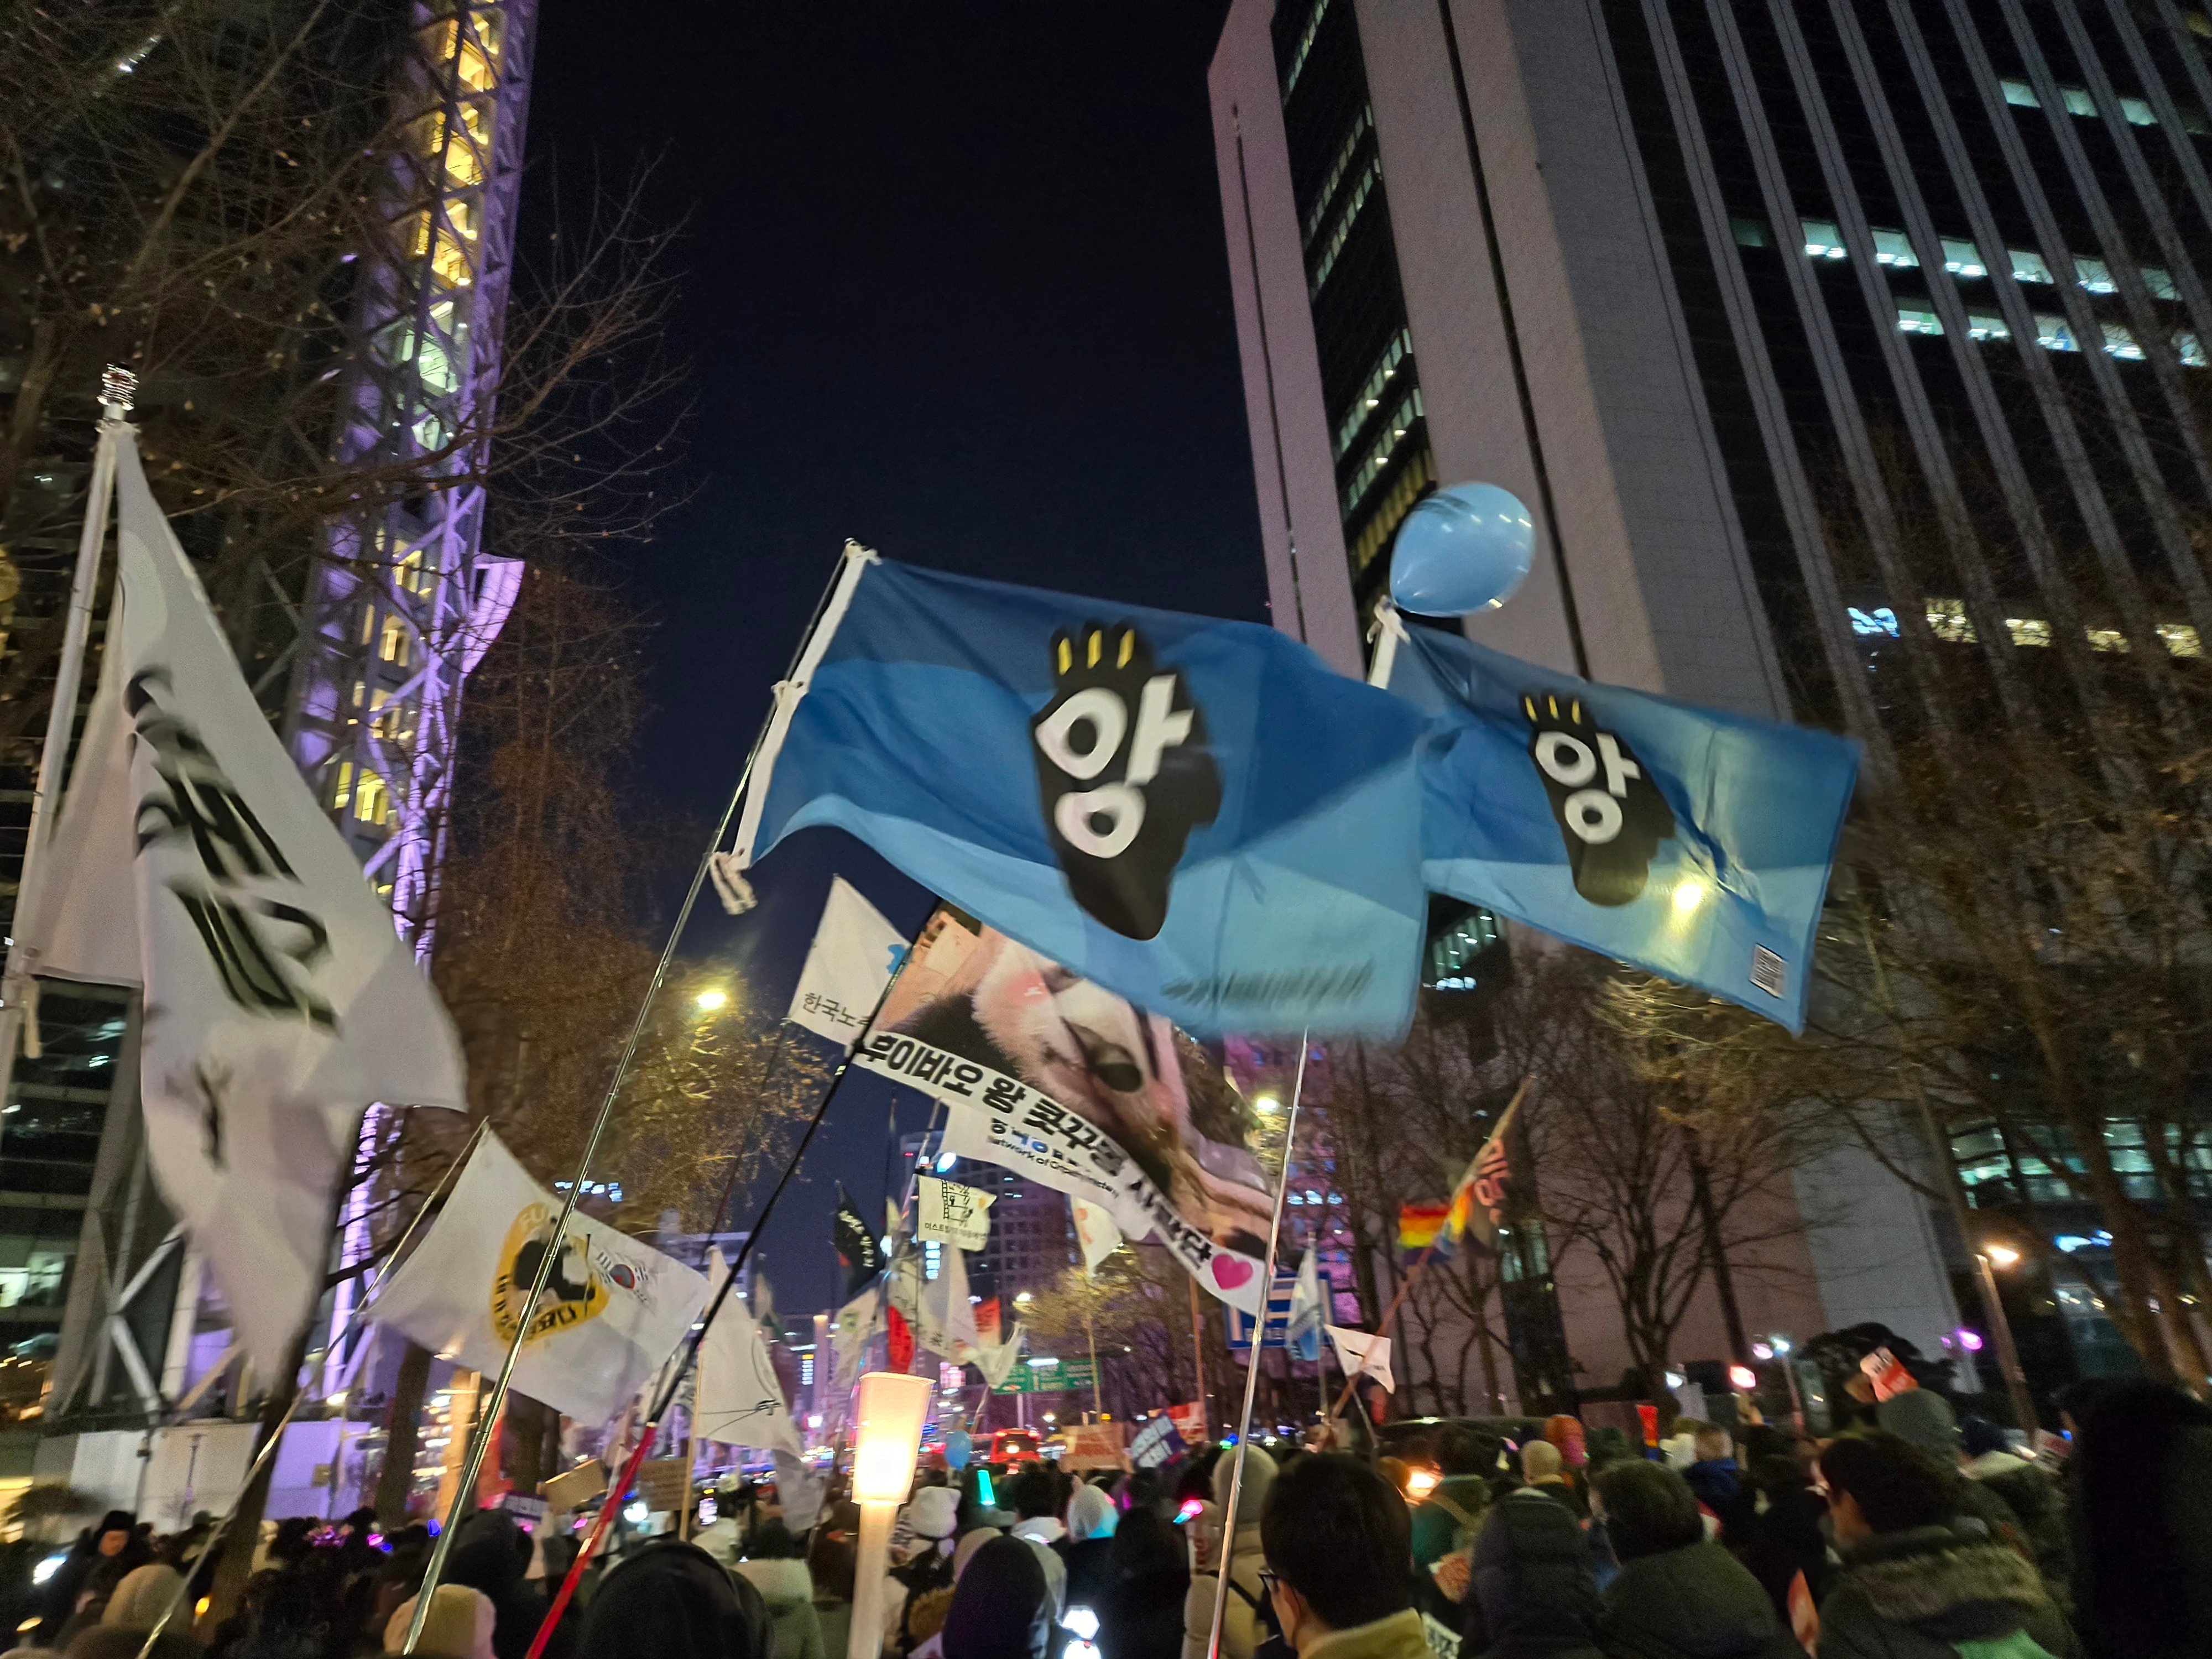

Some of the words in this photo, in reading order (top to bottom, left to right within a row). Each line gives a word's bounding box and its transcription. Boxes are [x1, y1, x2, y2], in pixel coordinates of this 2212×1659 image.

[1035, 674, 1194, 859] 앙
[1535, 731, 1641, 844] 앙
[982, 1077, 1026, 1114] 왕
